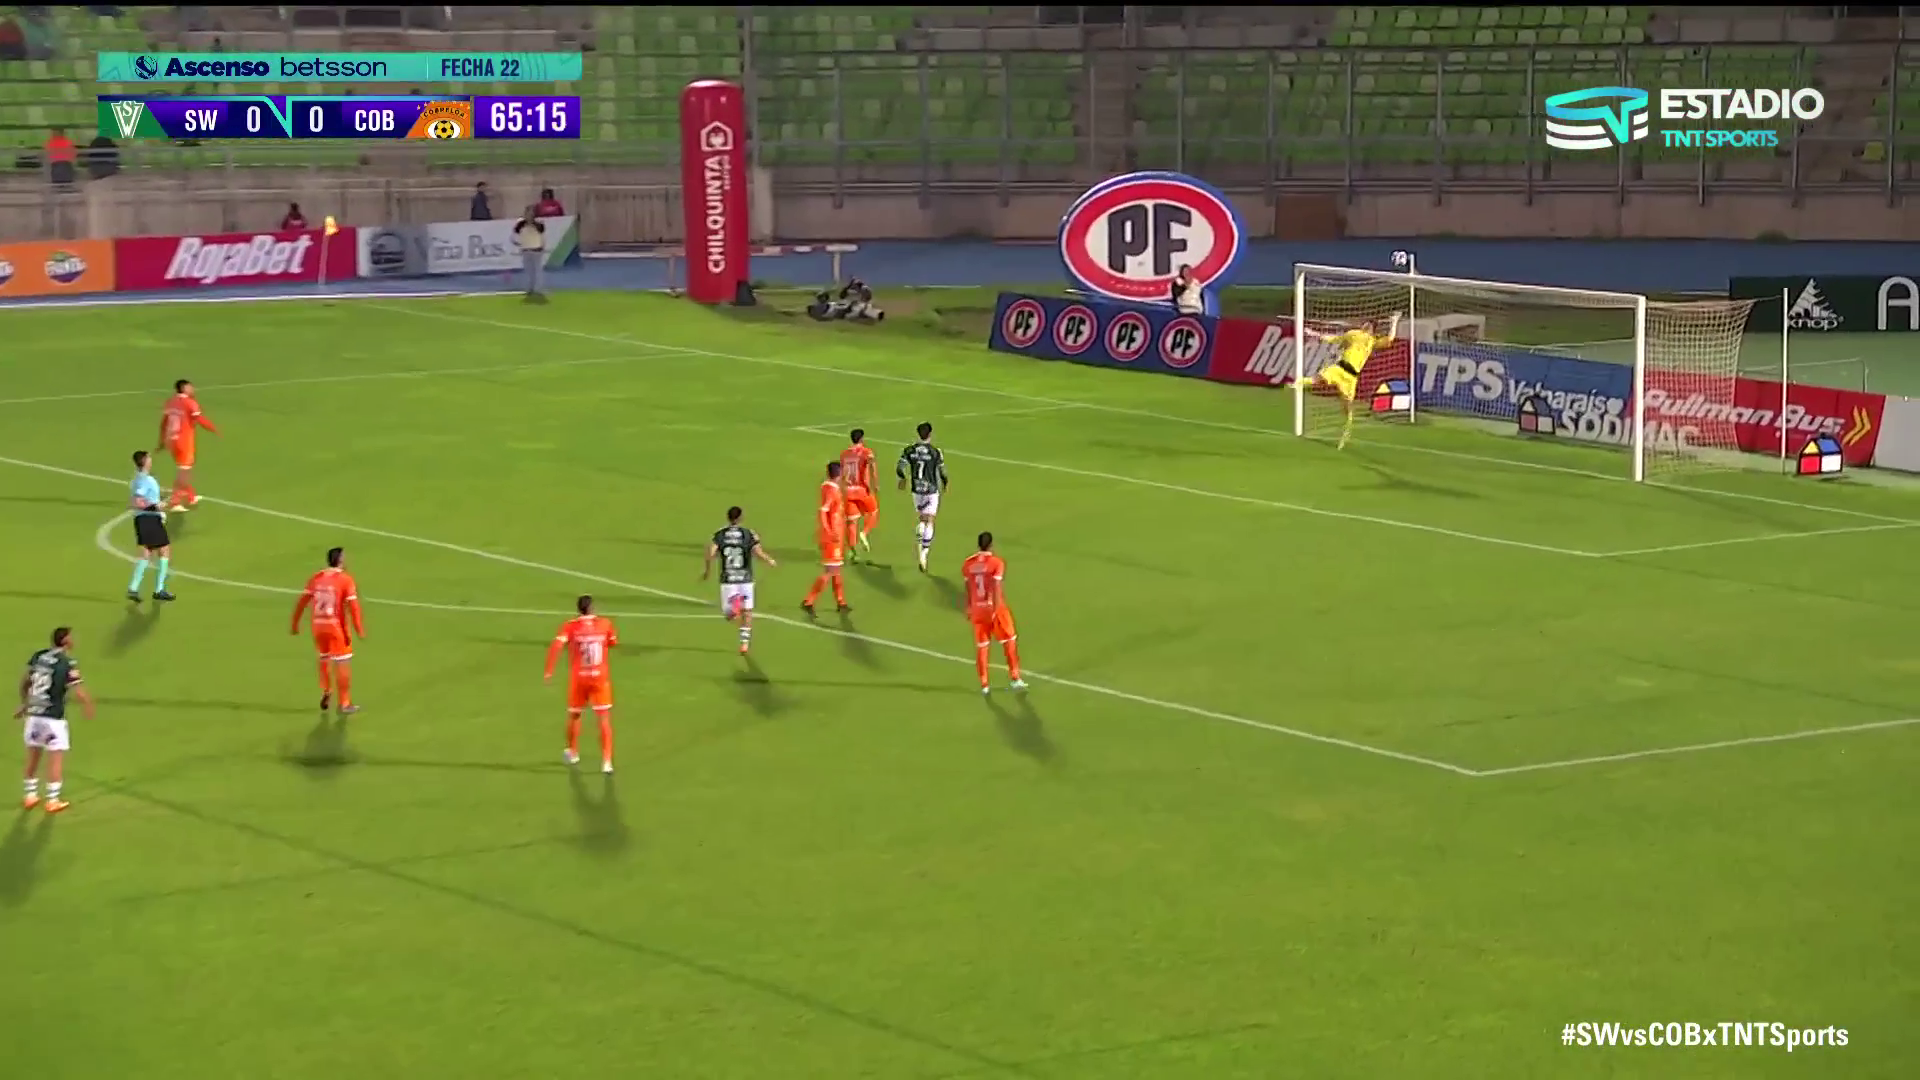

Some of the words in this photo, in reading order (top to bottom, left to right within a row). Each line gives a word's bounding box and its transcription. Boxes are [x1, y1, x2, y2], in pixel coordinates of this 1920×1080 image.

[704, 155, 726, 274] CHILQUINTA
[164, 235, 314, 284] RojaBet
[1107, 203, 1192, 276] PF
[1014, 309, 1035, 339] PF
[1063, 315, 1086, 344] PF
[1115, 321, 1139, 351] PF
[1170, 327, 1195, 358] PF
[1417, 351, 1505, 401] TPS
[1643, 388, 1774, 427] Pullman
[1773, 403, 1845, 435] Bus
